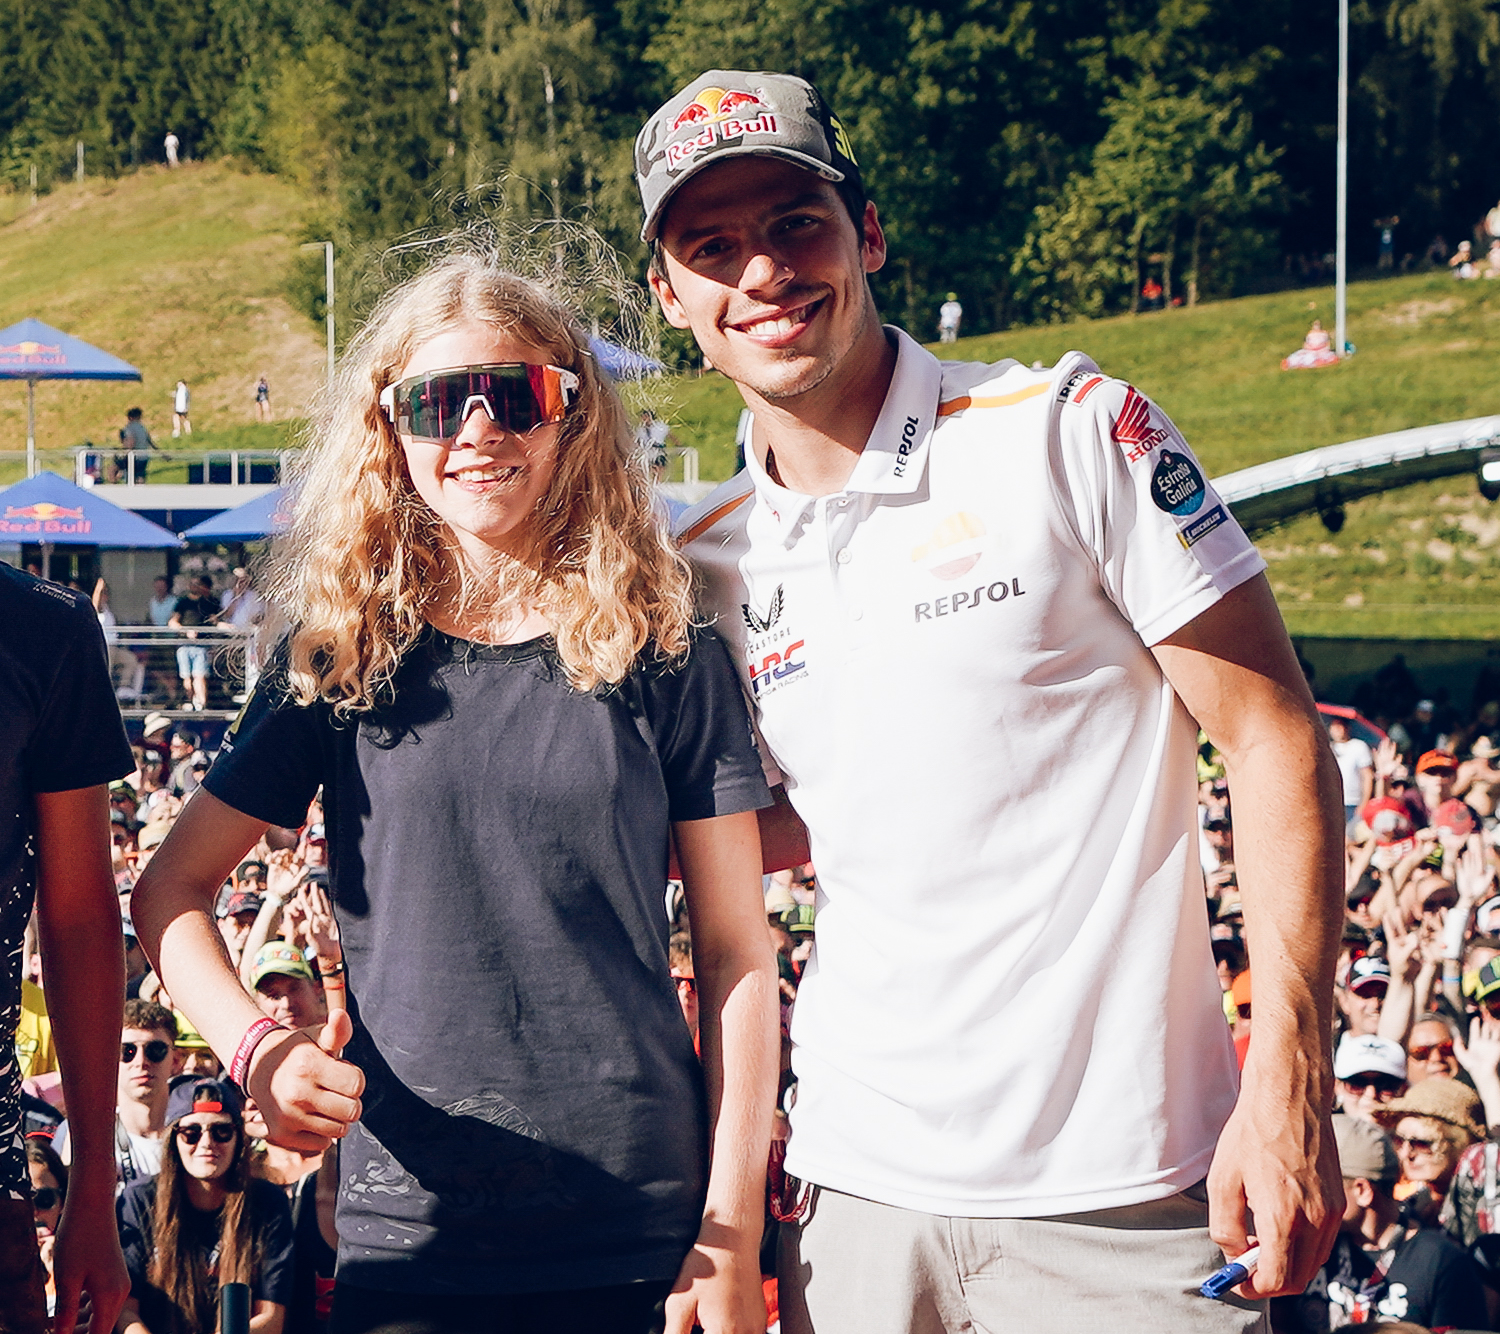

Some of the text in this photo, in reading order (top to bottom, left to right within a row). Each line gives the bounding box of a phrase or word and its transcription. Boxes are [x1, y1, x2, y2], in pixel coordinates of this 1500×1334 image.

[667, 115, 777, 168] Red Bull
[28, 355, 67, 365] Bull
[893, 415, 919, 478] REPSOL
[1127, 430, 1169, 463] HOND
[45, 520, 92, 534] Bull
[914, 577, 1026, 623] REPSOL
